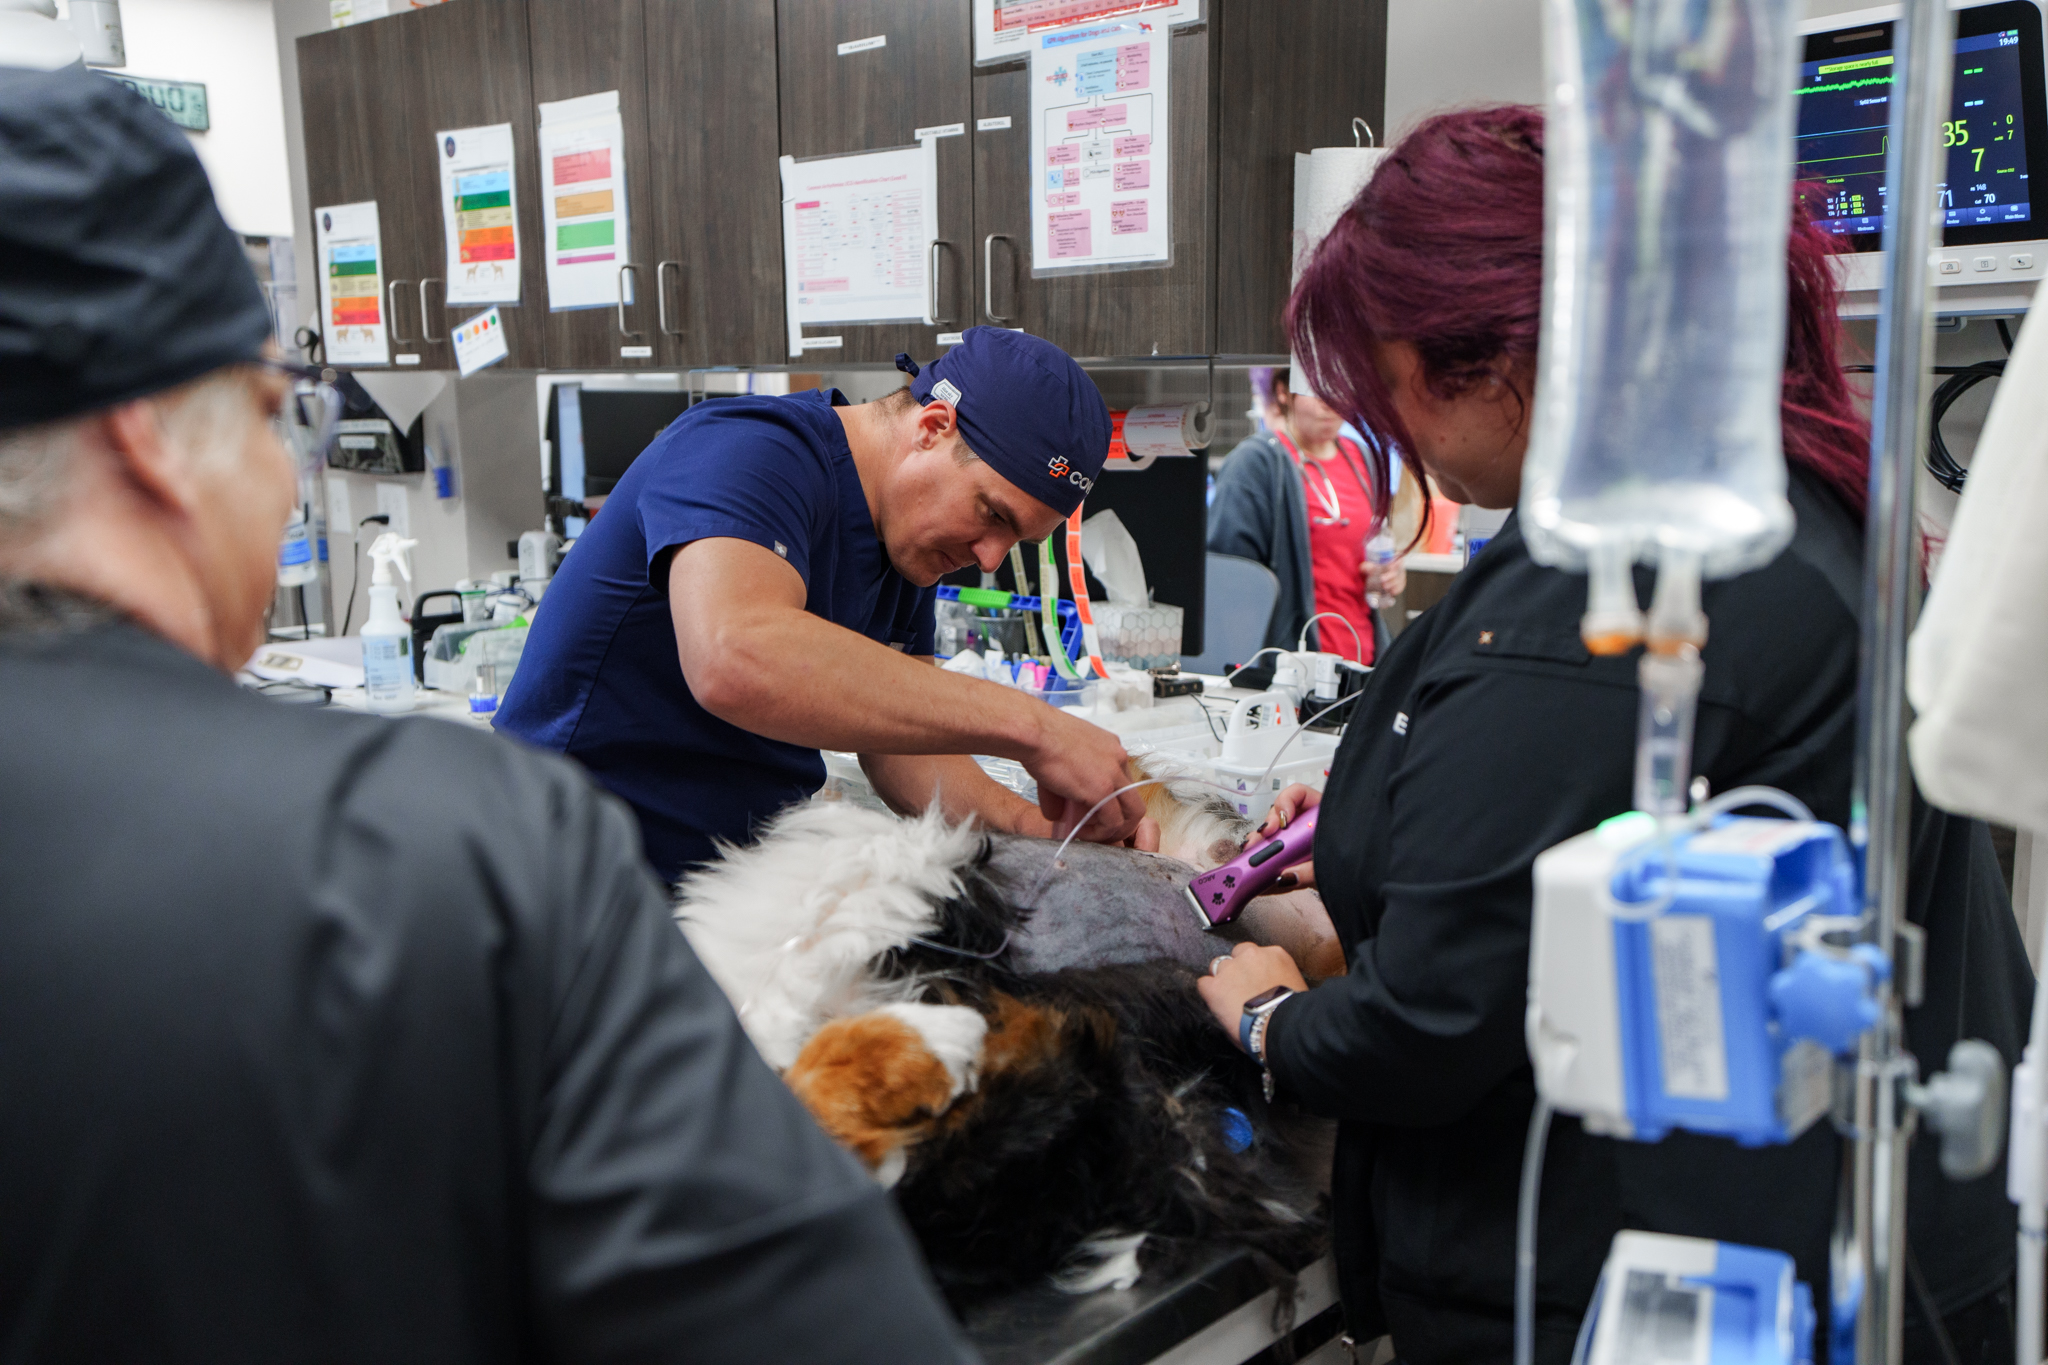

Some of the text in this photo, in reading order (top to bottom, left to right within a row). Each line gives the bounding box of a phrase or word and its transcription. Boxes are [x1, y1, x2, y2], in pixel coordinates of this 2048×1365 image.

[1999, 36, 2019, 46] 19:49
[2006, 114, 2014, 125] 0
[2007, 129, 2014, 140] 7
[1971, 148, 1985, 172] 7
[1984, 193, 1996, 204] 70
[1198, 873, 1216, 885] ARCO
